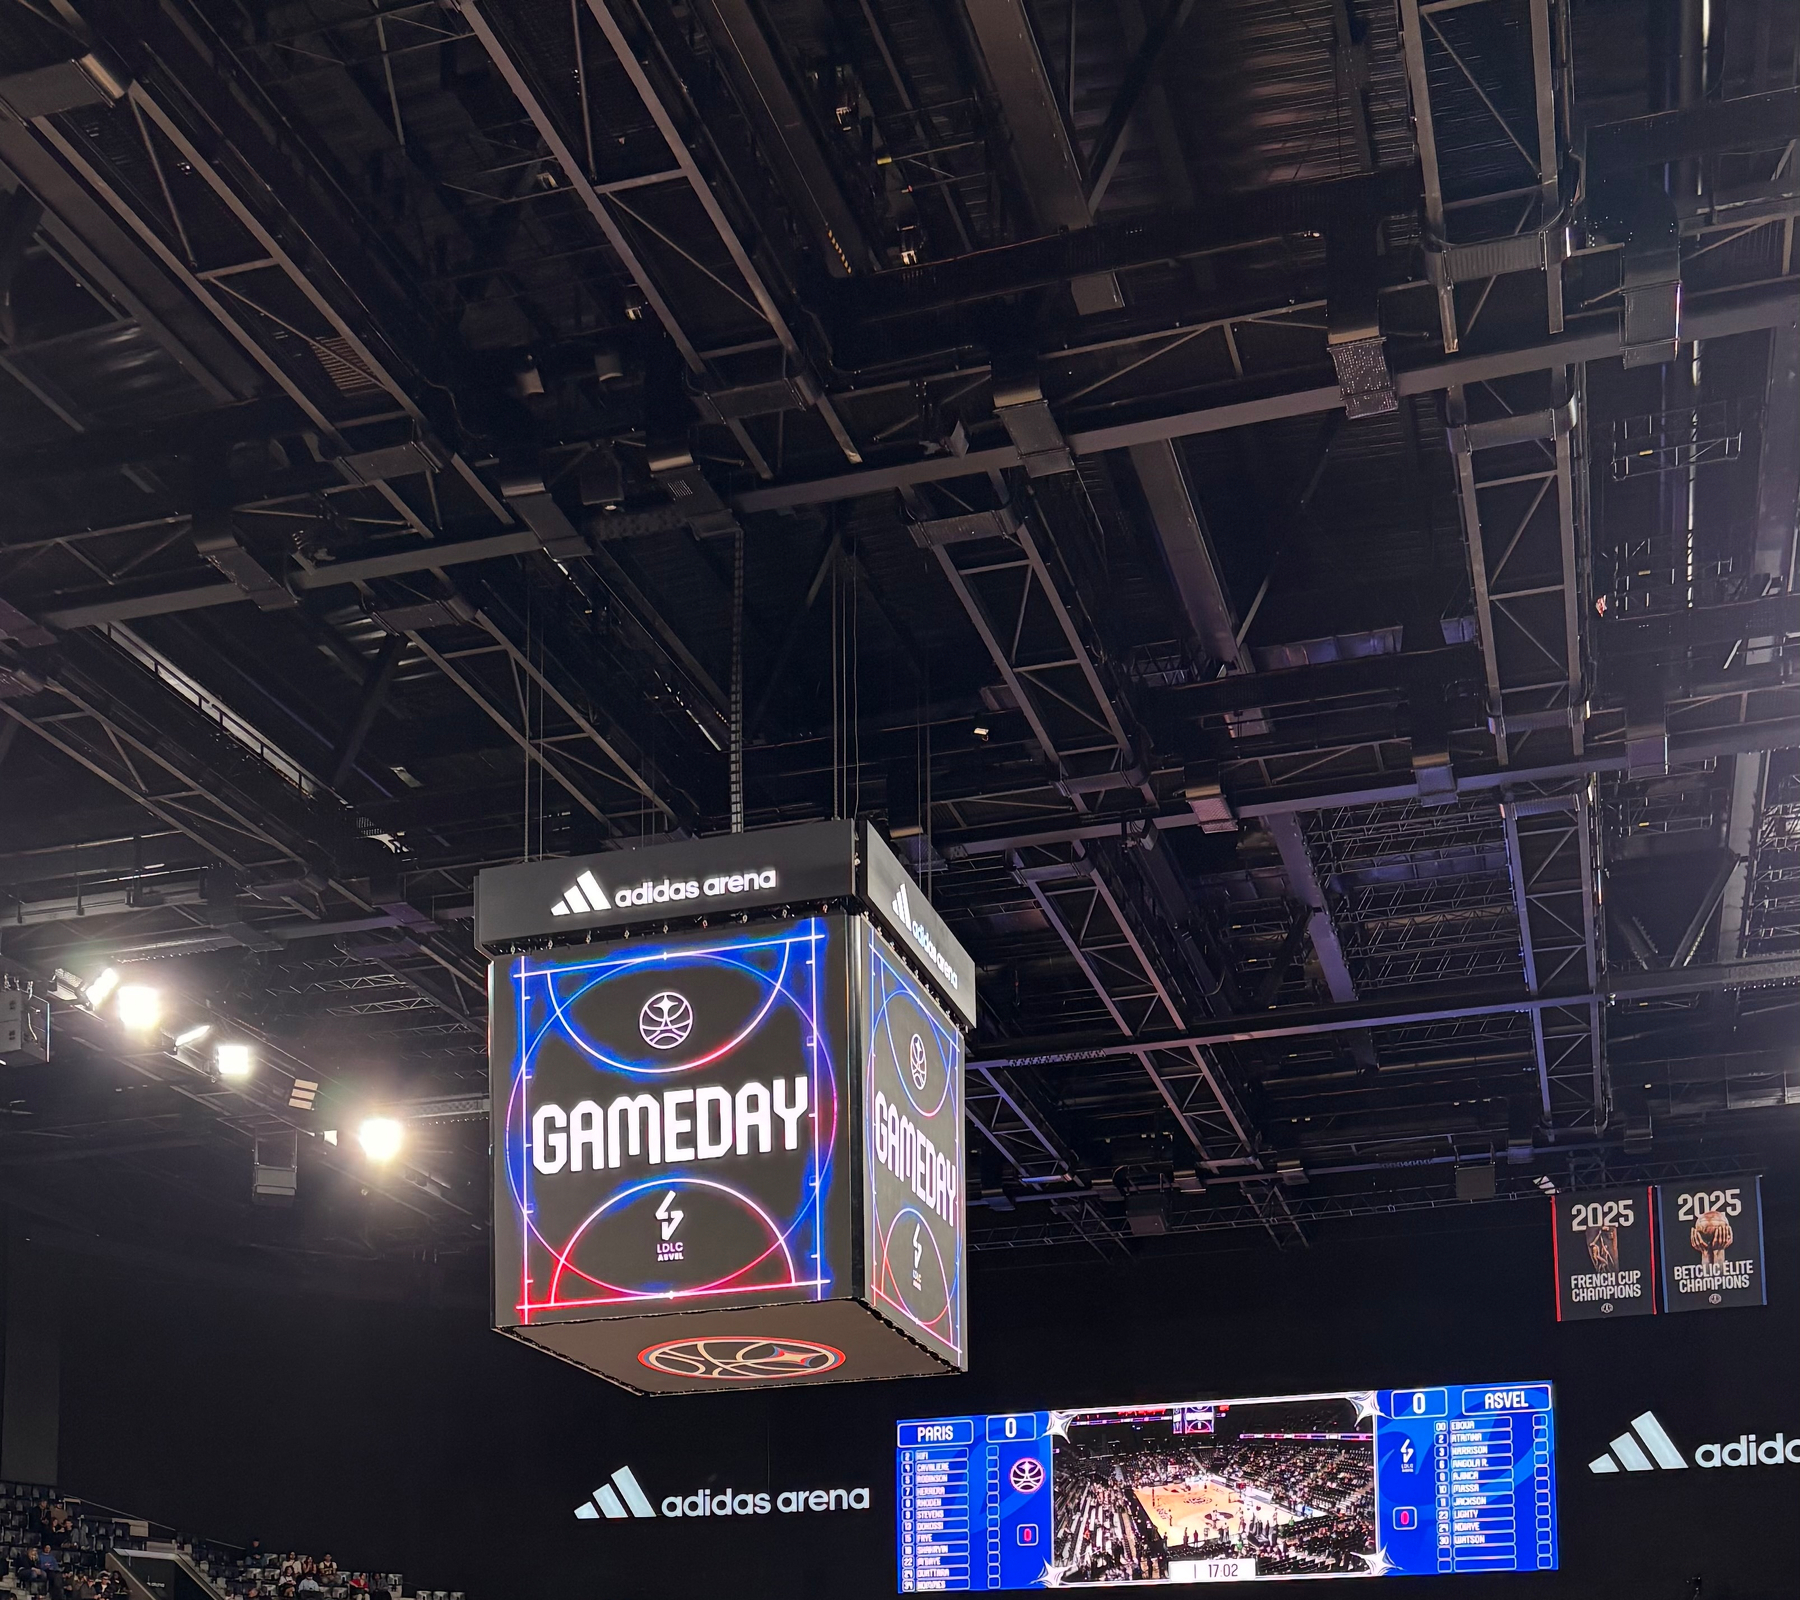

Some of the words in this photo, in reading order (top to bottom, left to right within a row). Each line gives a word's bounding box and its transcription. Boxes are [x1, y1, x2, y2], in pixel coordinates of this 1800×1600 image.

[615, 877, 700, 908] adidas
[703, 869, 776, 896] arena
[912, 920, 937, 964] adidas
[936, 954, 958, 990] arena
[532, 1076, 808, 1175] GAMEDAY
[875, 1090, 957, 1227] GAMEDAY
[1678, 1189, 1741, 1221] 2025
[1571, 1199, 1634, 1231] 2025
[656, 1242, 683, 1253] LDLC
[657, 1252, 684, 1261] ASVEL
[1571, 1273, 1615, 1289] FRENCH
[1618, 1270, 1641, 1285] CUP
[1674, 1263, 1721, 1281] BETCLIC
[1571, 1283, 1641, 1302] CHAMPIONS
[1679, 1275, 1750, 1294] CHAMPIONS
[1412, 1392, 1426, 1414] 0
[1484, 1391, 1528, 1410] ASVEL
[917, 1424, 953, 1442] PARIS
[1005, 1418, 1017, 1438] 0
[662, 1488, 771, 1518] adidas
[777, 1487, 870, 1512] arena
[1208, 1563, 1238, 1578] 17:02
